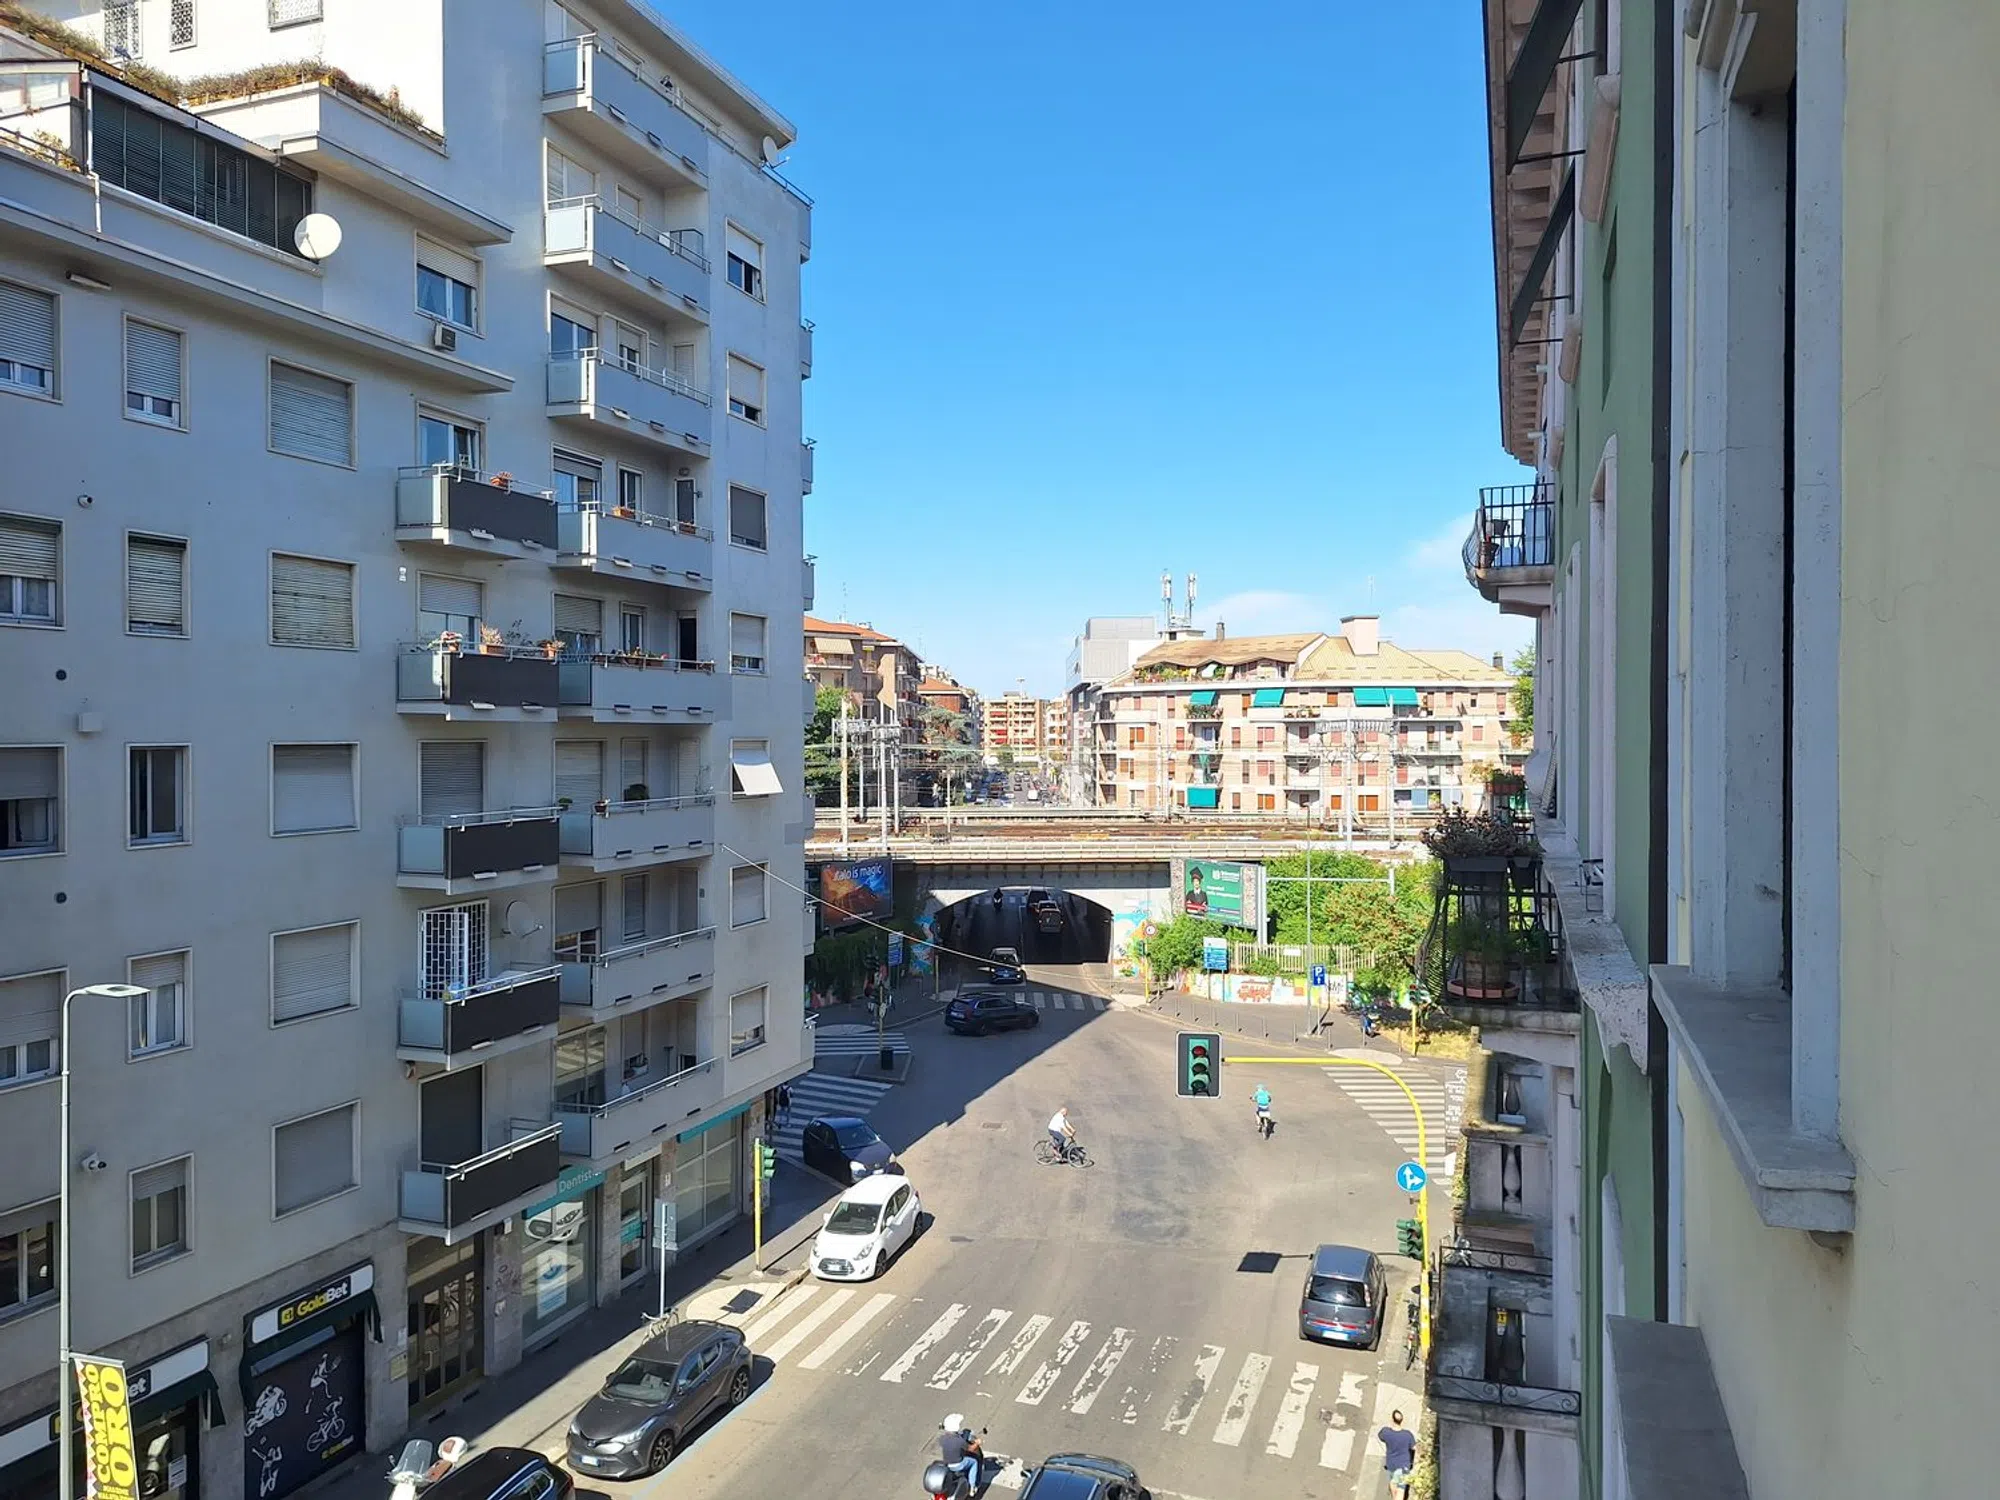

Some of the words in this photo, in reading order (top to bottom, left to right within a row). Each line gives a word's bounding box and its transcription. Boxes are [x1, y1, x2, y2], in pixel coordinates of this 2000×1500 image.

[852, 866, 859, 879] is
[860, 863, 883, 877] magic
[1315, 967, 1323, 977] P
[559, 1170, 597, 1194] Dentist
[297, 1282, 348, 1316] GoldBet
[85, 1364, 111, 1484] COMPRO
[100, 1367, 134, 1487] ORO
